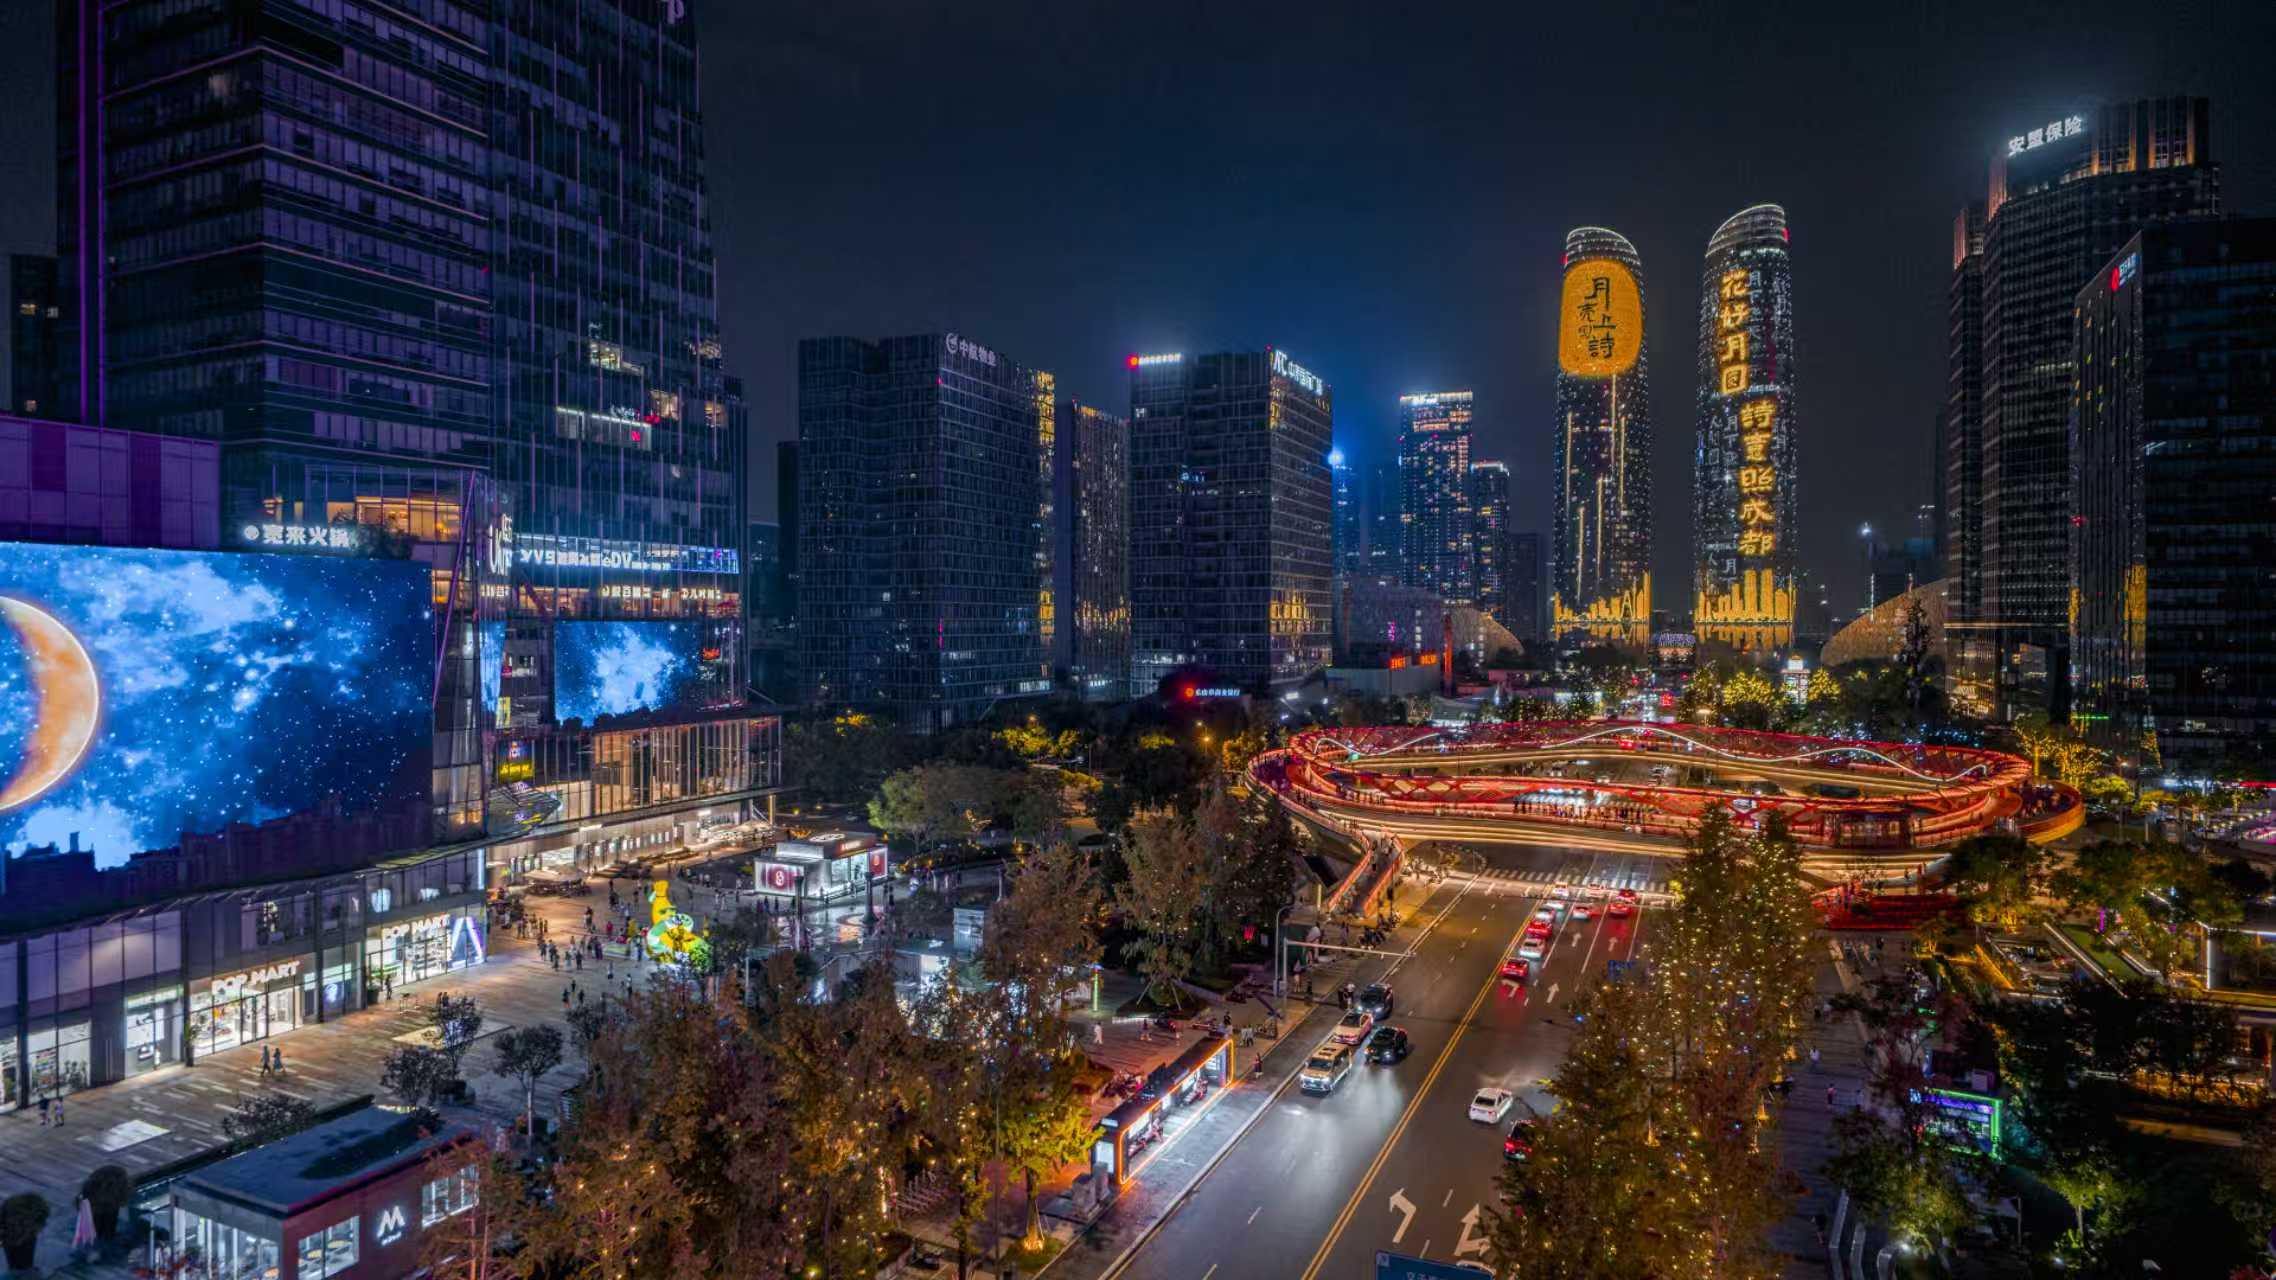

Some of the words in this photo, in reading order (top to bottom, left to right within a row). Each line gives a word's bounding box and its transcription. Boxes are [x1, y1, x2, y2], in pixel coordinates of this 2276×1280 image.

[2008, 115, 2082, 157] 安盟保险
[381, 923, 411, 940] POP
[411, 914, 450, 935] MART
[211, 974, 248, 996] POP
[251, 960, 301, 985] MART
